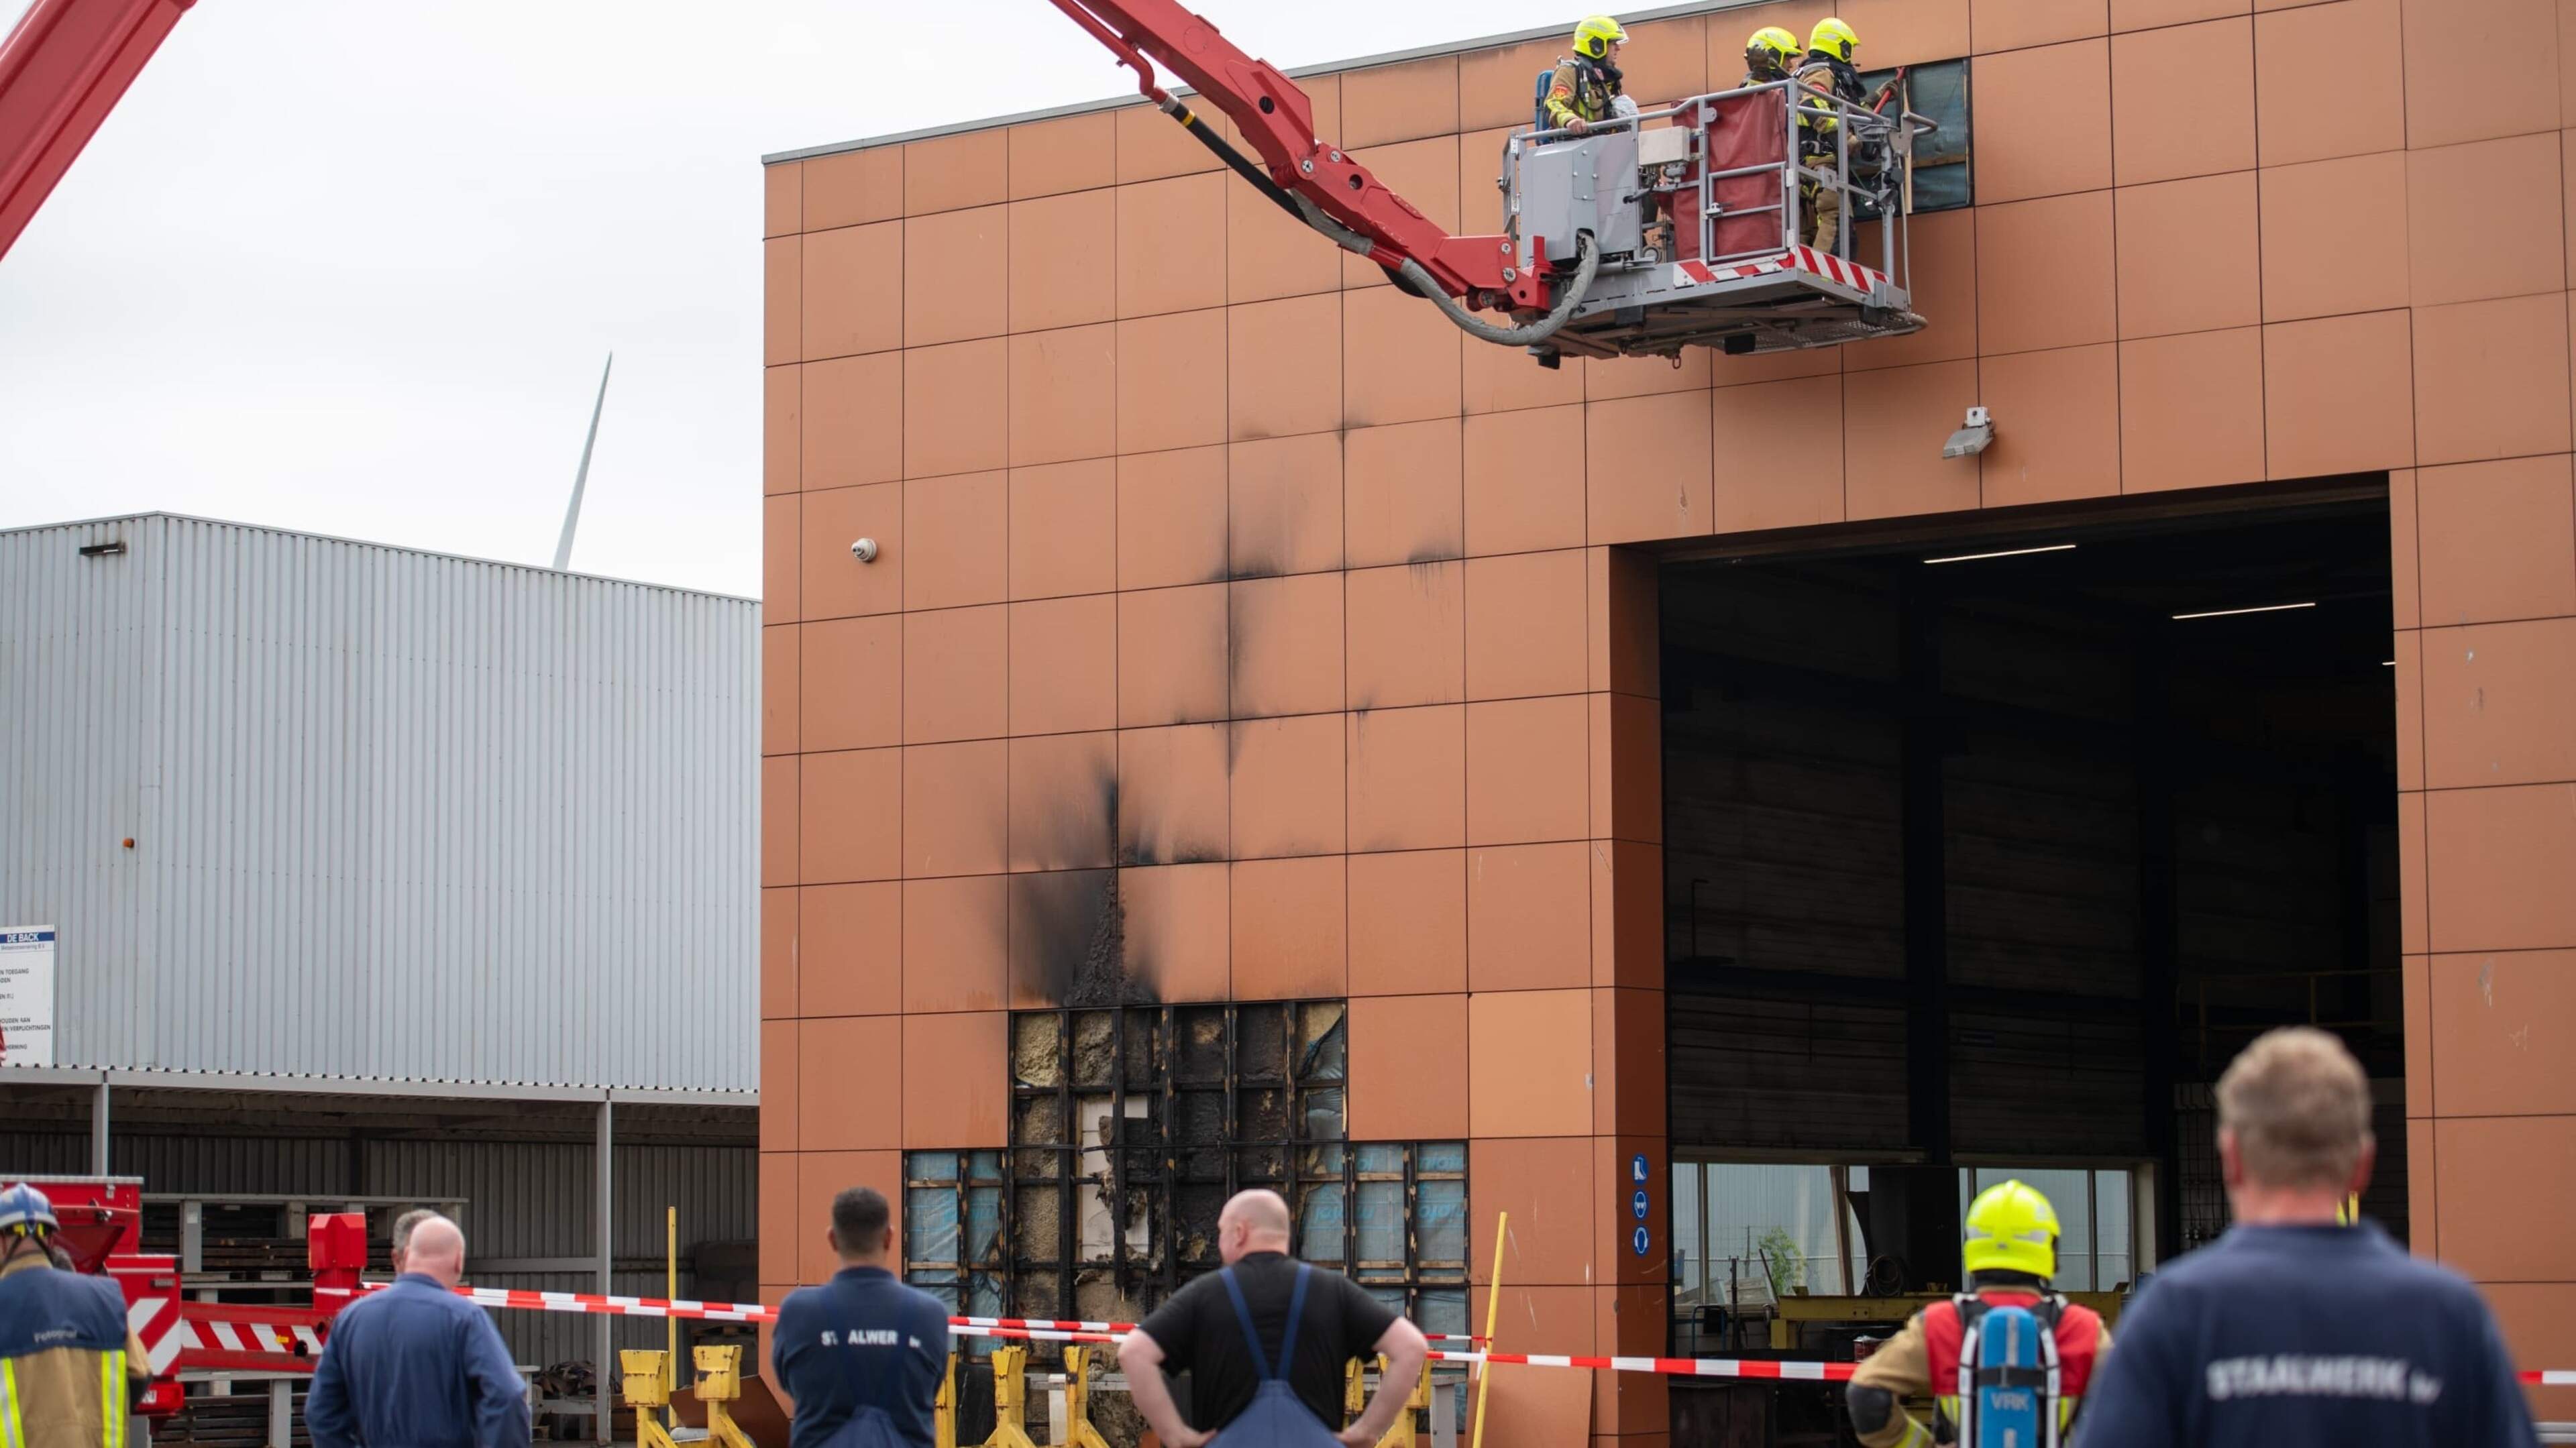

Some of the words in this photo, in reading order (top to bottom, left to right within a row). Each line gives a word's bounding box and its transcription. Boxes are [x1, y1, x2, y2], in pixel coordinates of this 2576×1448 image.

[7, 934, 17, 943] DE
[18, 932, 40, 942] BACK
[2205, 1352, 2409, 1402] STAALWERK
